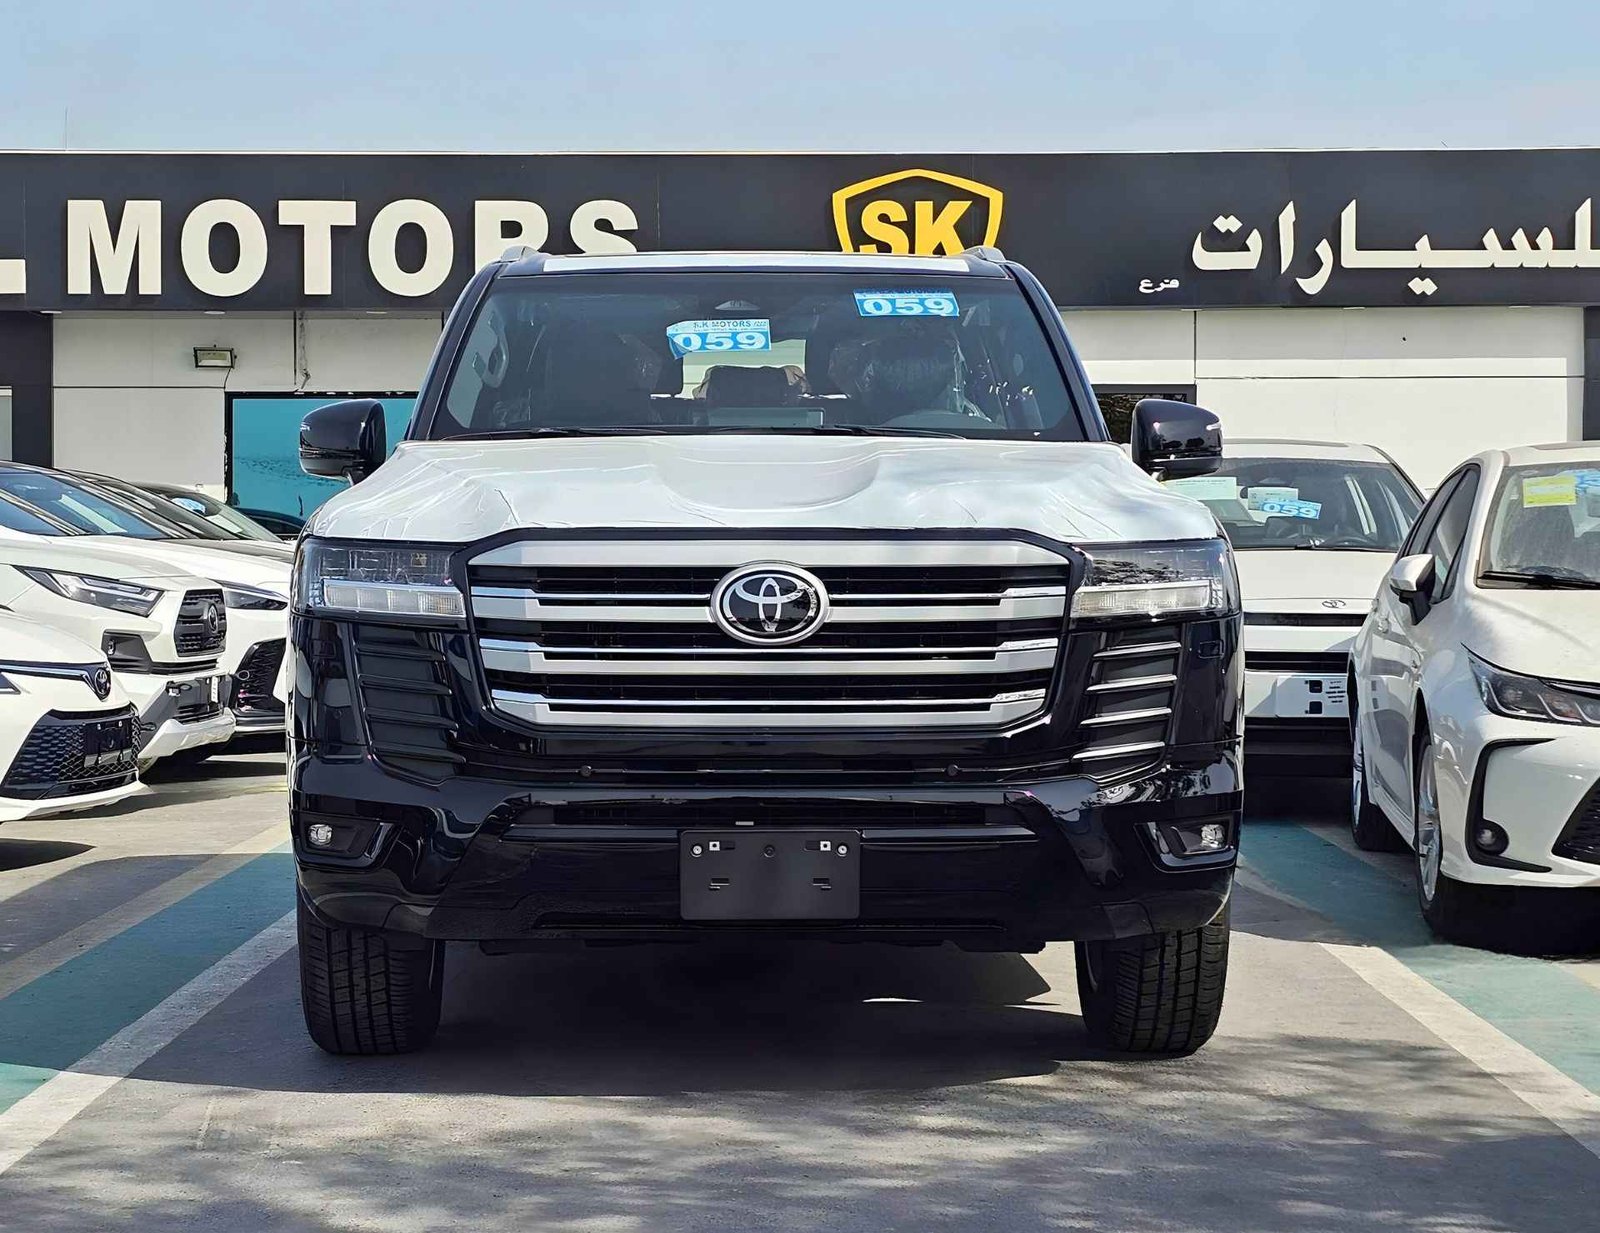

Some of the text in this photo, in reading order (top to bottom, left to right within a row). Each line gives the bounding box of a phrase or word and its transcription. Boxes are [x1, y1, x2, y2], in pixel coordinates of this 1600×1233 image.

[859, 200, 973, 256] SK
[1192, 198, 1600, 295] لسيارات
[67, 199, 639, 297] MOTORS
[863, 298, 954, 315] 059
[674, 332, 766, 350] 059
[1263, 502, 1318, 517] 059
